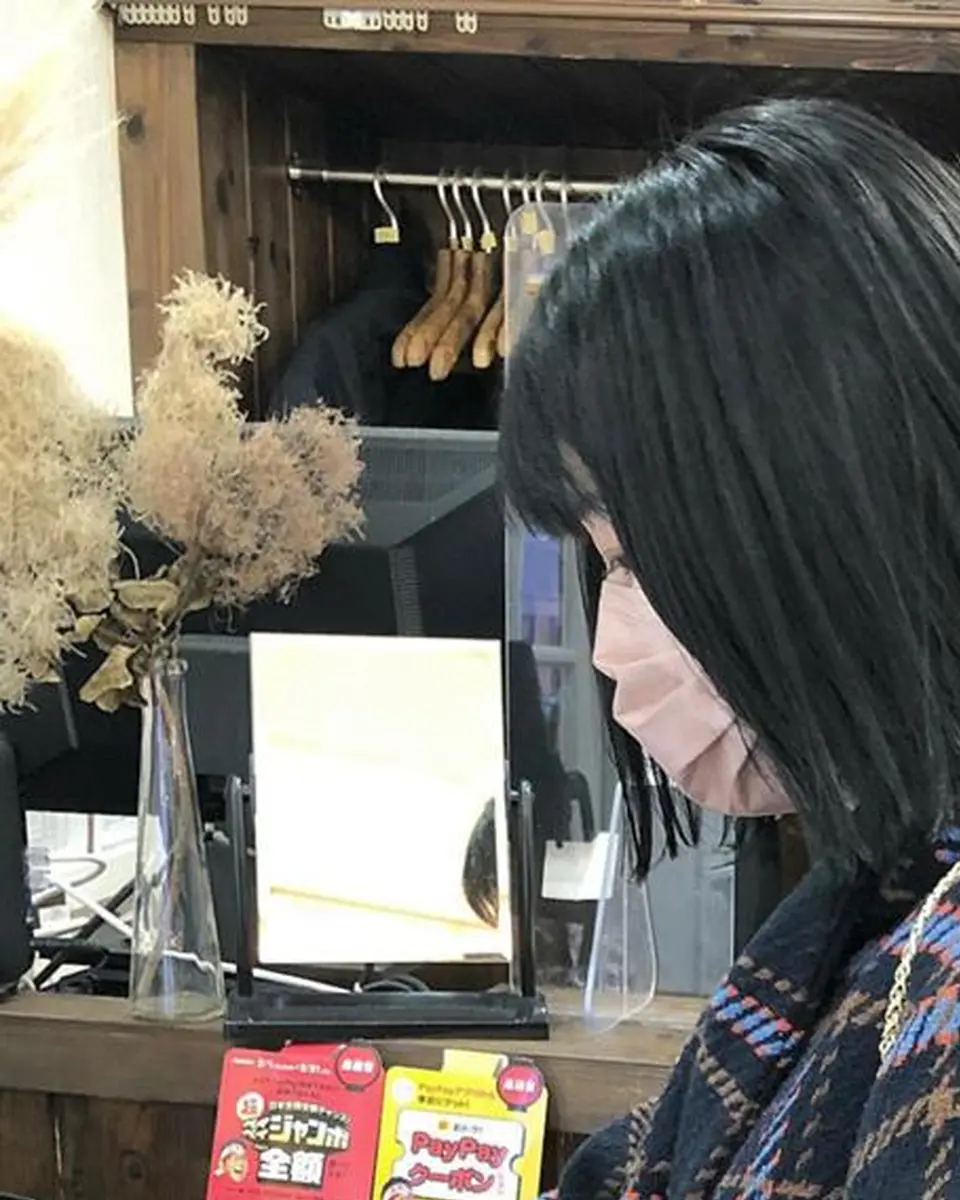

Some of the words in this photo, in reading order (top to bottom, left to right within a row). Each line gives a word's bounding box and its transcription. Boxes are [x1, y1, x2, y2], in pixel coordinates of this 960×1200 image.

[258, 1148, 325, 1185] 全額
[411, 1131, 508, 1168] PayPay
[408, 1163, 494, 1193] クーポン
